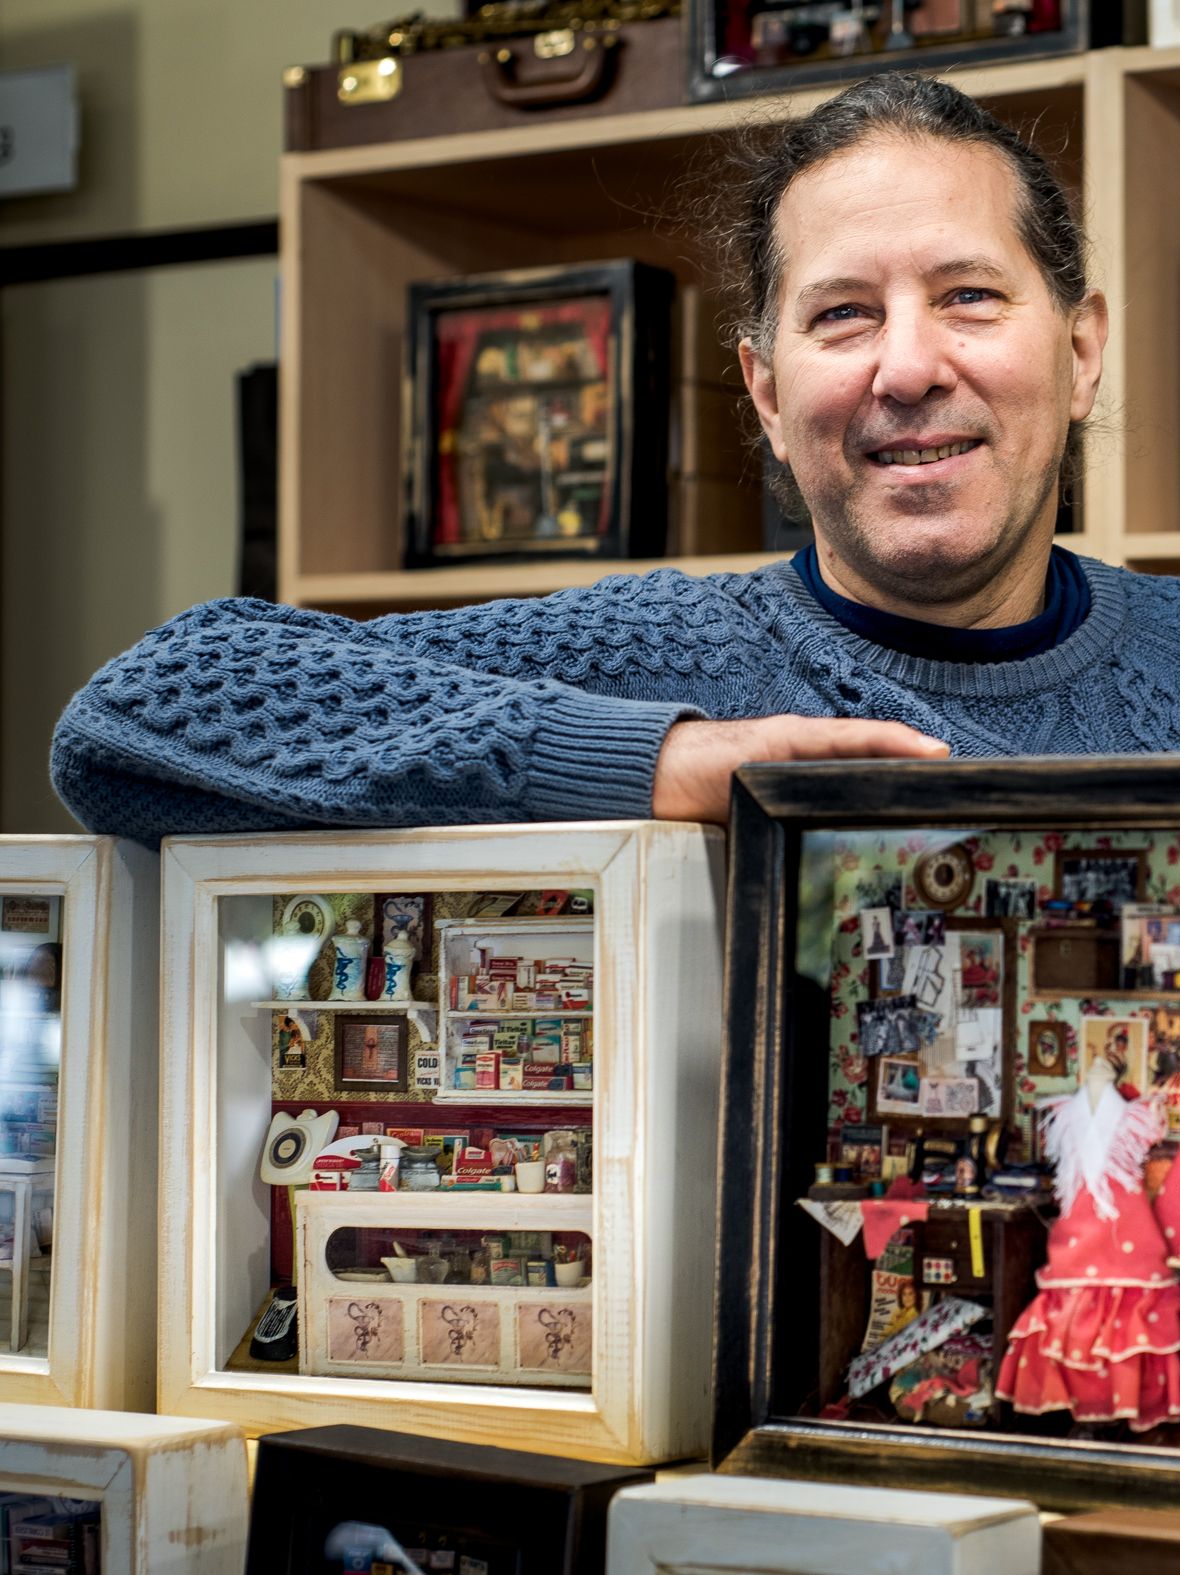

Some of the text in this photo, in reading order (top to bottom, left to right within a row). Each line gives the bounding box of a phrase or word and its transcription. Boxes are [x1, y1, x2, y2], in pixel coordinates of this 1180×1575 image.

[417, 1057, 438, 1068] COLD
[524, 1064, 554, 1074] Colgate
[416, 1077, 431, 1086] VICKS
[522, 1078, 549, 1088] Colgate
[456, 1167, 492, 1176] Colgate
